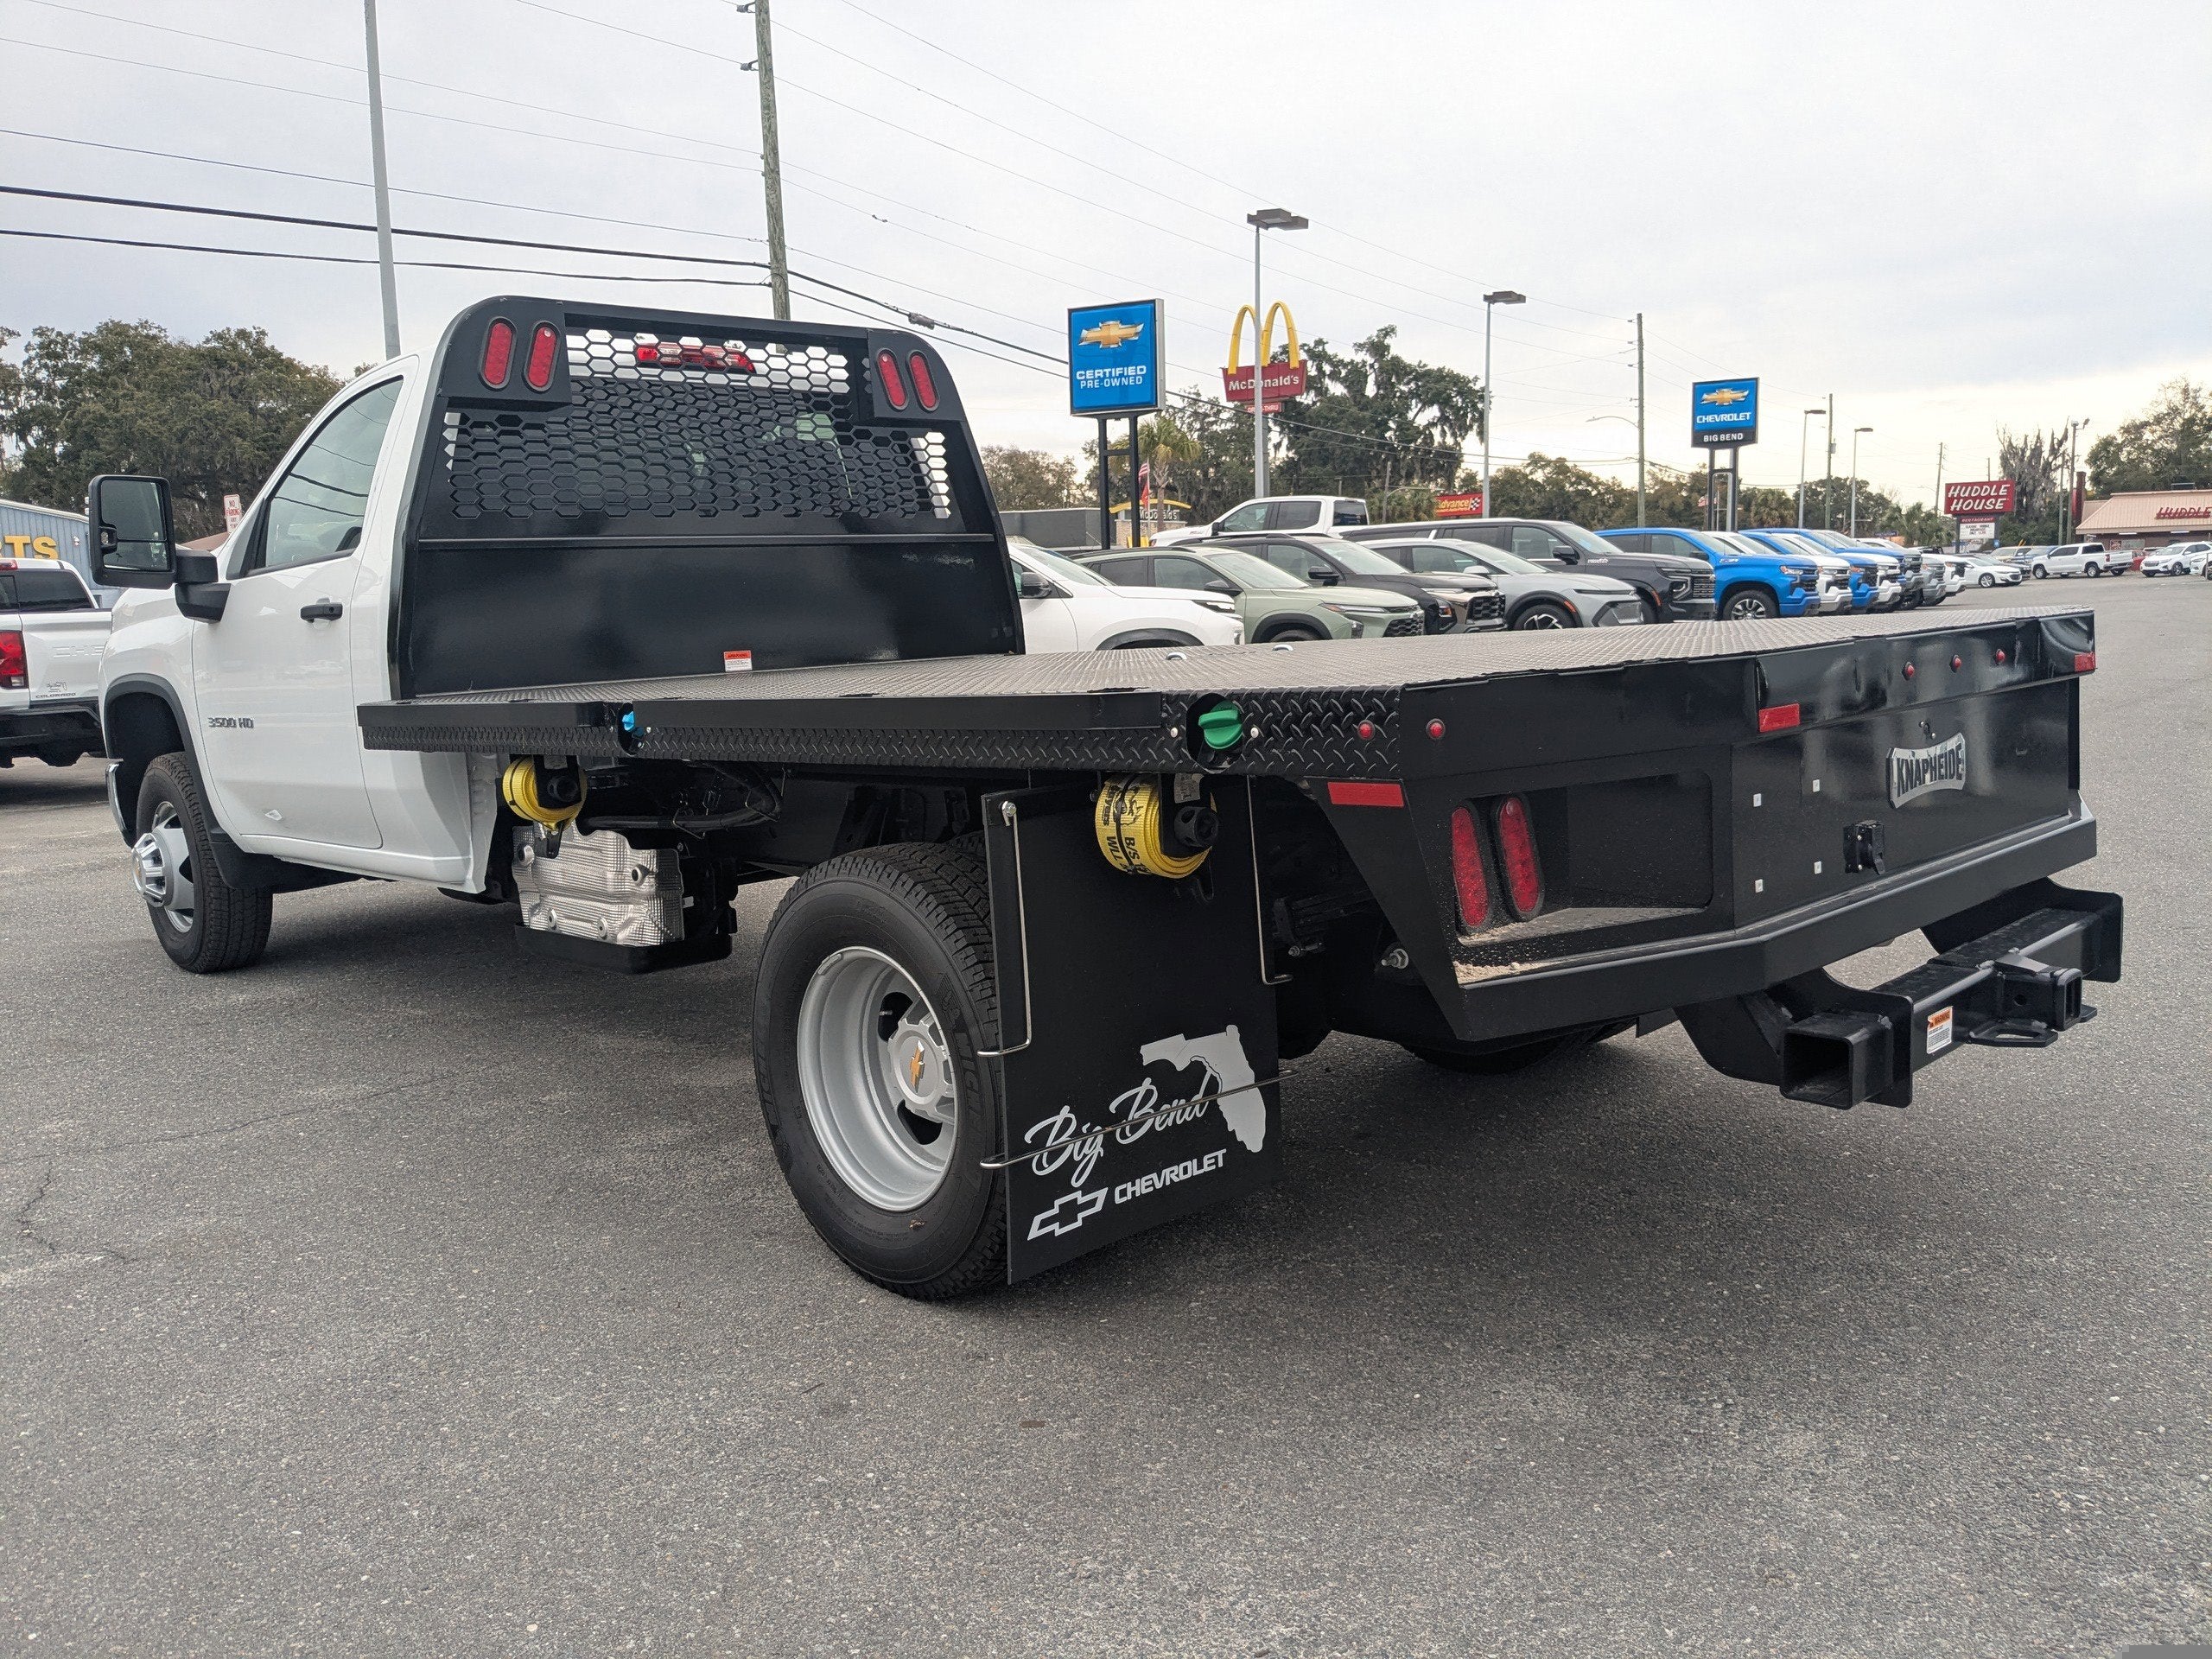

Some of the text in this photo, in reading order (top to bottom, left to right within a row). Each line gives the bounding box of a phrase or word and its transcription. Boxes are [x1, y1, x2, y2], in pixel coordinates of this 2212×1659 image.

[1076, 365, 1147, 380] CERTIFIED
[1080, 376, 1143, 389] PRE-OWNED
[1229, 374, 1300, 391] McDnald's
[1696, 411, 1751, 423] CHEVROLET
[1719, 432, 1744, 442] BEND
[1948, 484, 2011, 499] HUDDLE
[1950, 498, 2007, 512] HOUSE
[2155, 506, 2212, 519] HUDDLE
[0, 535, 59, 560] TS
[208, 717, 254, 729] 3500 HD
[1896, 742, 1962, 798] KNAPHEIDE
[1124, 836, 1141, 860] B/S
[1024, 1069, 1213, 1188] Big Bend
[1115, 1148, 1227, 1205] CHEVROLET
